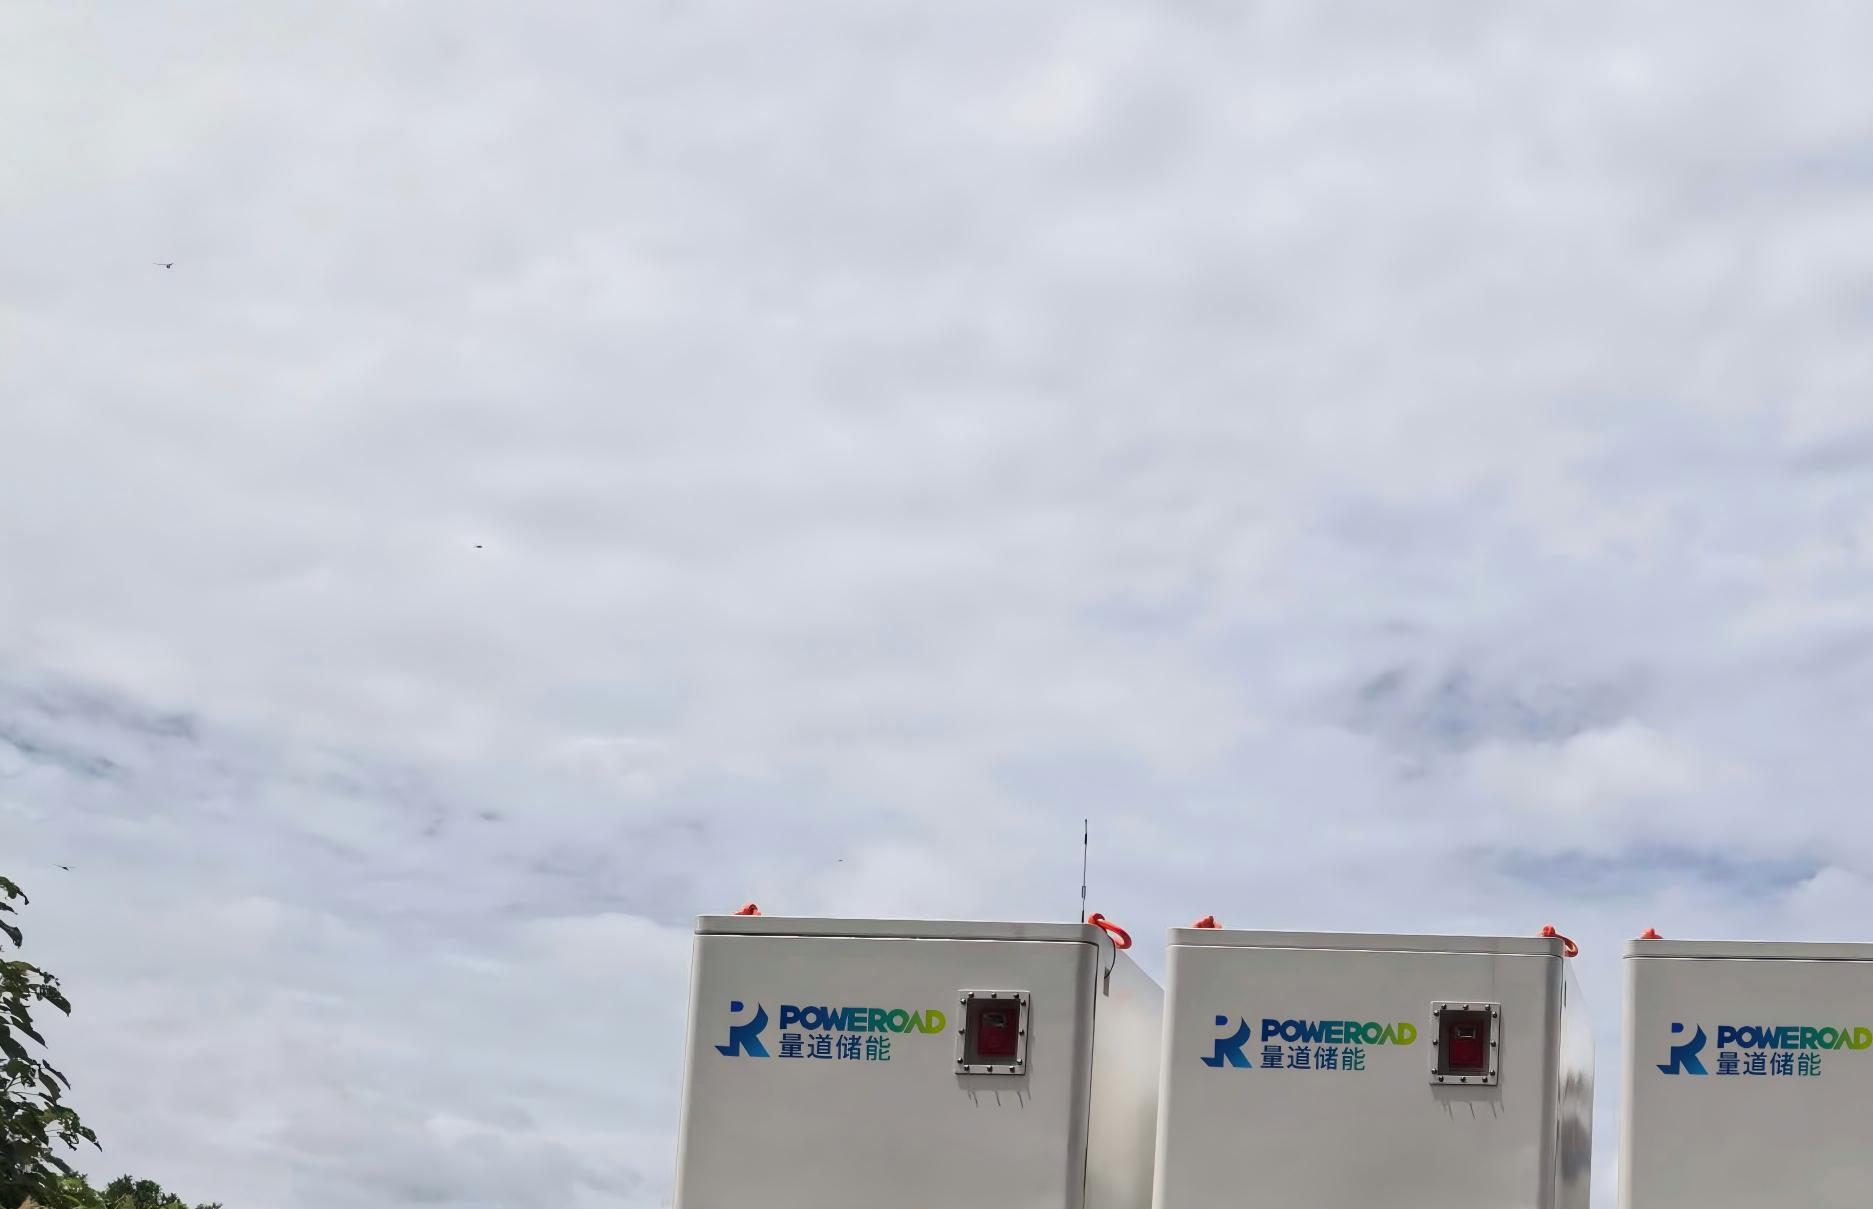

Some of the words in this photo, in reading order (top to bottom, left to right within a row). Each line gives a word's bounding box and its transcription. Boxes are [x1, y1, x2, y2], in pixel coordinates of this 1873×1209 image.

[779, 1004, 946, 1034] POWEROAD
[1261, 1019, 1417, 1045] POWEROAD
[779, 1033, 891, 1061] 量道储能
[1717, 1025, 1873, 1050] POWEROAD
[1260, 1045, 1366, 1071] 量道储能
[1716, 1051, 1822, 1076] 量道储能
